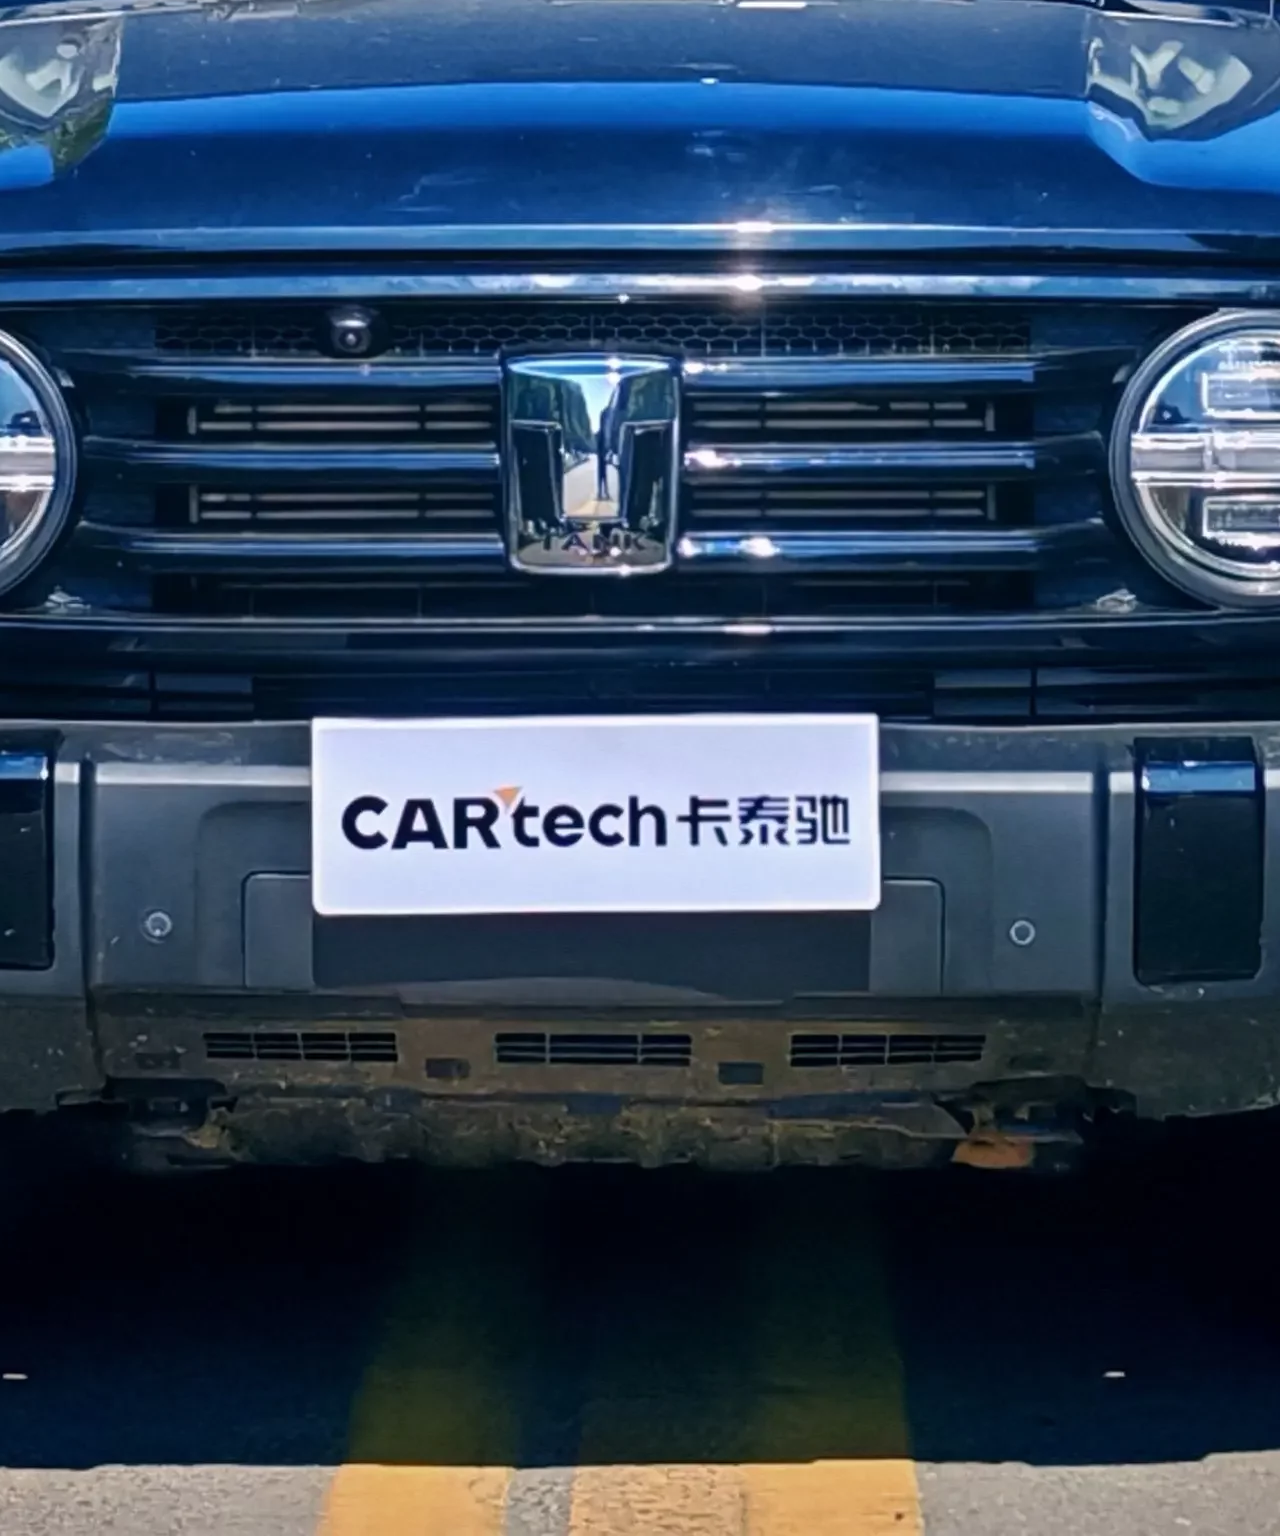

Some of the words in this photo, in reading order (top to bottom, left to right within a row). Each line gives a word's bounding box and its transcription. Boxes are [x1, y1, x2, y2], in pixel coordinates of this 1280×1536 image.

[541, 530, 646, 553] TANK
[340, 791, 667, 850] CARtech
[677, 794, 851, 846] 卡泰驰
